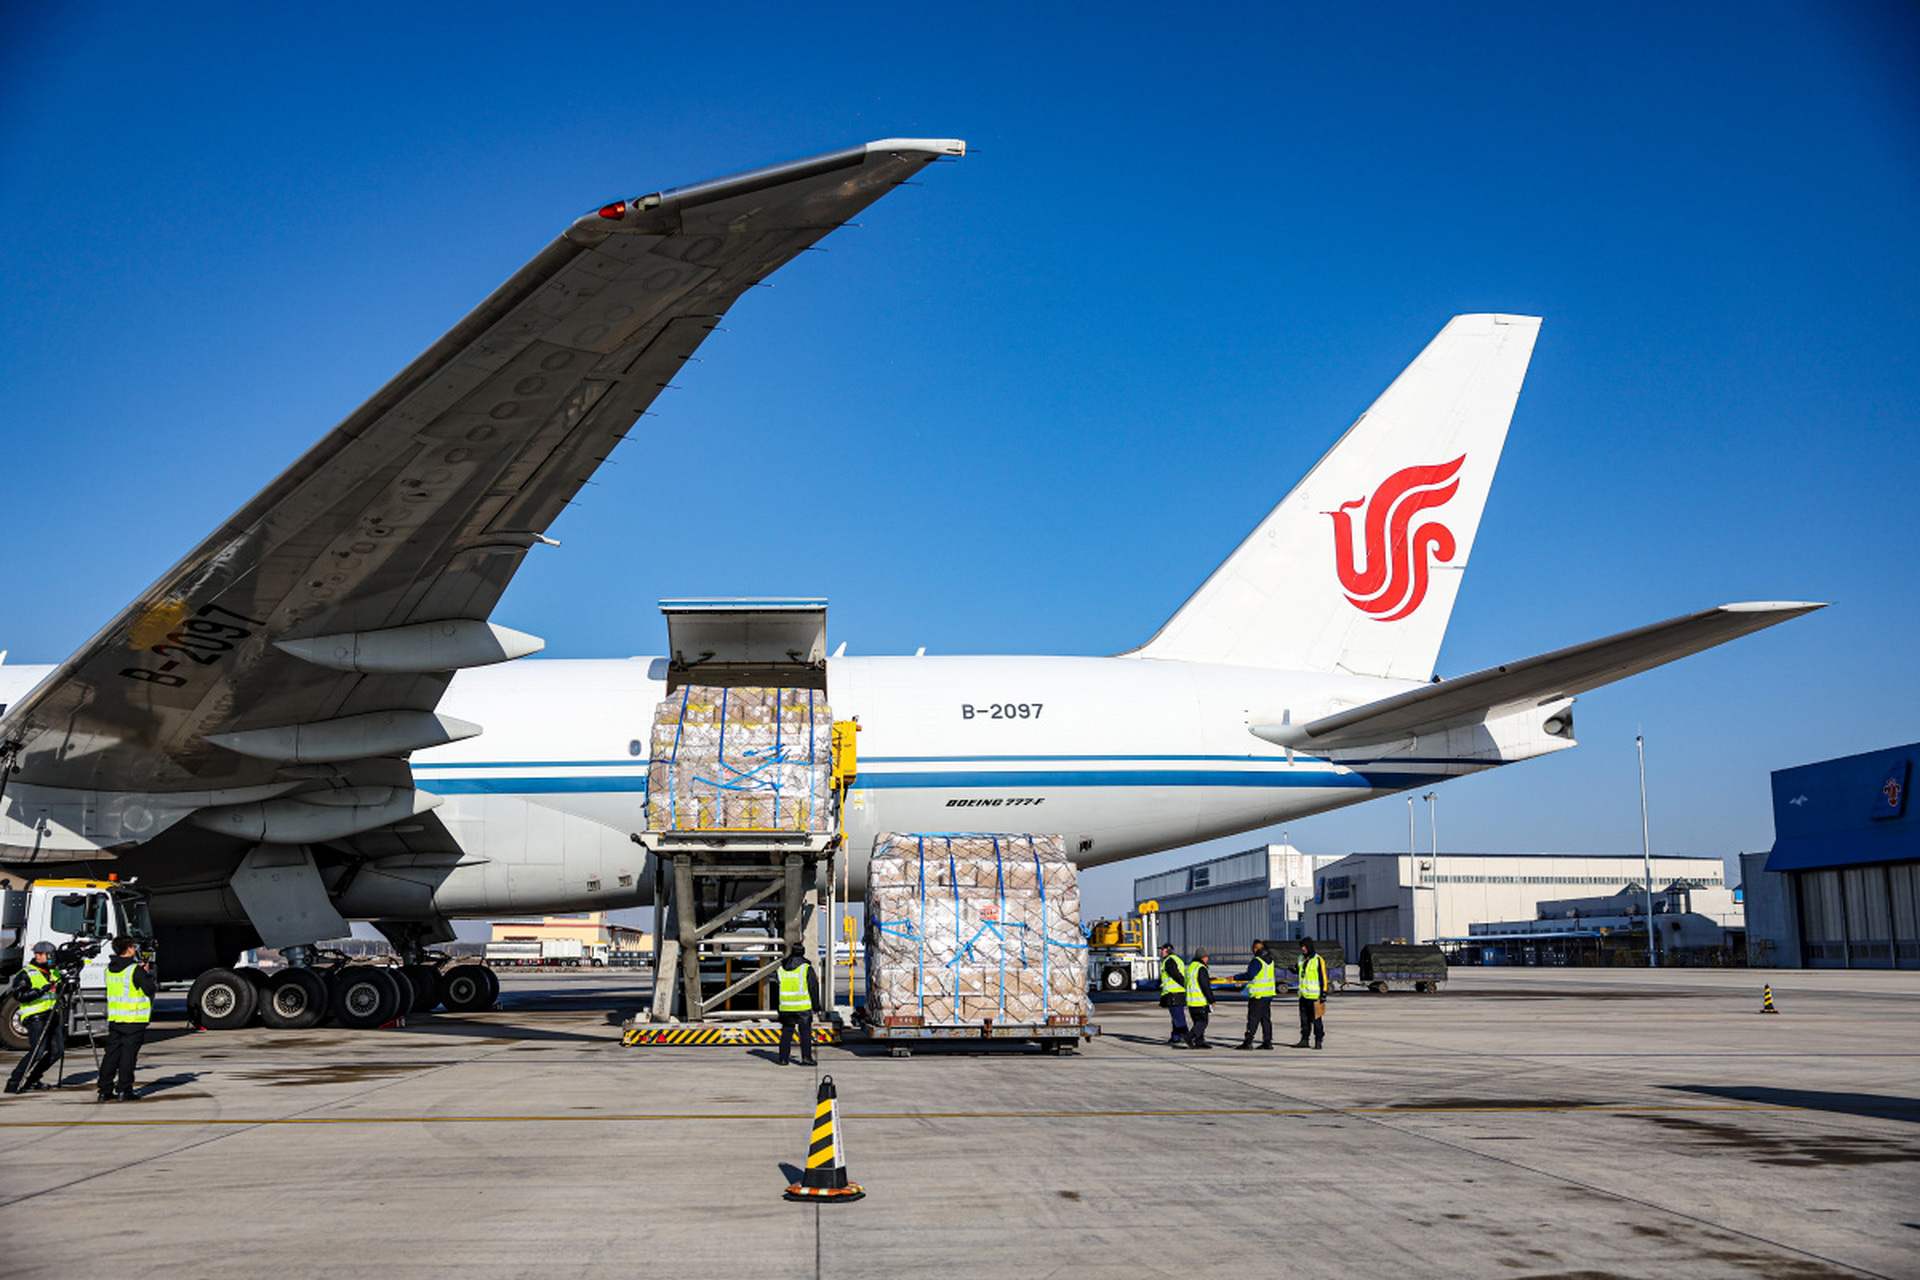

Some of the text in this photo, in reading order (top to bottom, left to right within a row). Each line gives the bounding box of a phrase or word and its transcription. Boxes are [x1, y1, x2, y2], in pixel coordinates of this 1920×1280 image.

[118, 603, 267, 688] B-2097
[962, 703, 1043, 720] B-2097
[945, 799, 1004, 807] BOEING
